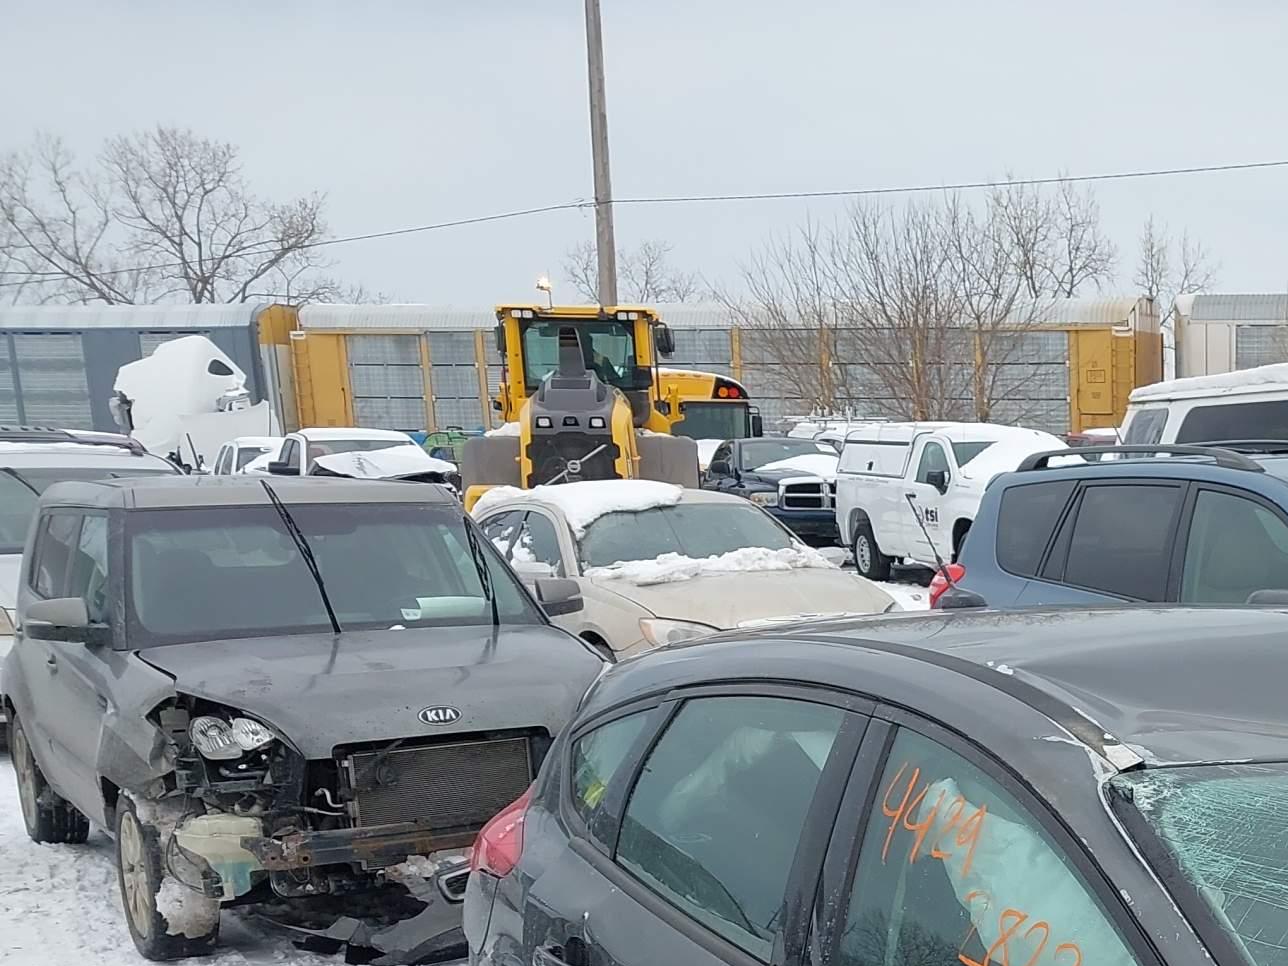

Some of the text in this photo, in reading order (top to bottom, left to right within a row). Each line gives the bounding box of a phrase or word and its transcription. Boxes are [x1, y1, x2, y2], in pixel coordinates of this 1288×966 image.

[925, 507, 939, 523] tsi
[426, 708, 457, 721] KIA
[882, 761, 988, 880] 4429
